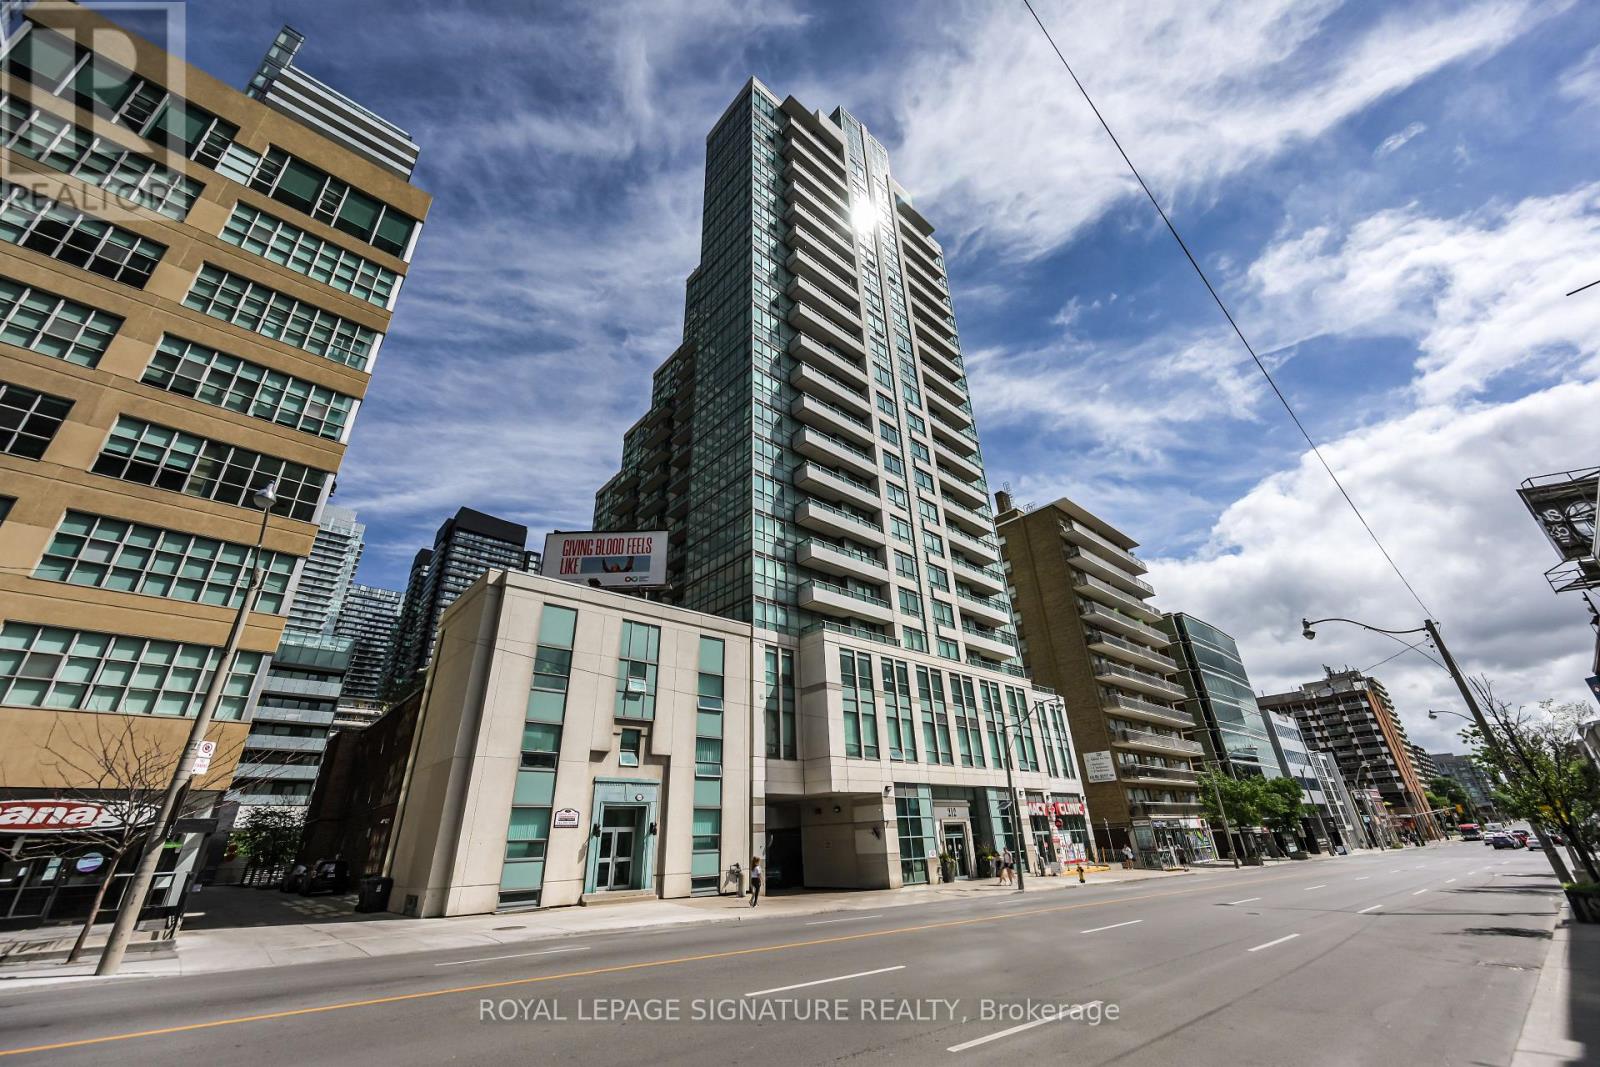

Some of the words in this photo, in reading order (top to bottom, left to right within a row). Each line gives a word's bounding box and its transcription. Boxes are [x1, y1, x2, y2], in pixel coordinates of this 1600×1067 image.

[562, 539, 594, 556] GIVING
[595, 538, 624, 555] BLOOD
[626, 537, 652, 554] FEELS
[560, 557, 579, 574] LIKE
[0, 805, 156, 827] anago
